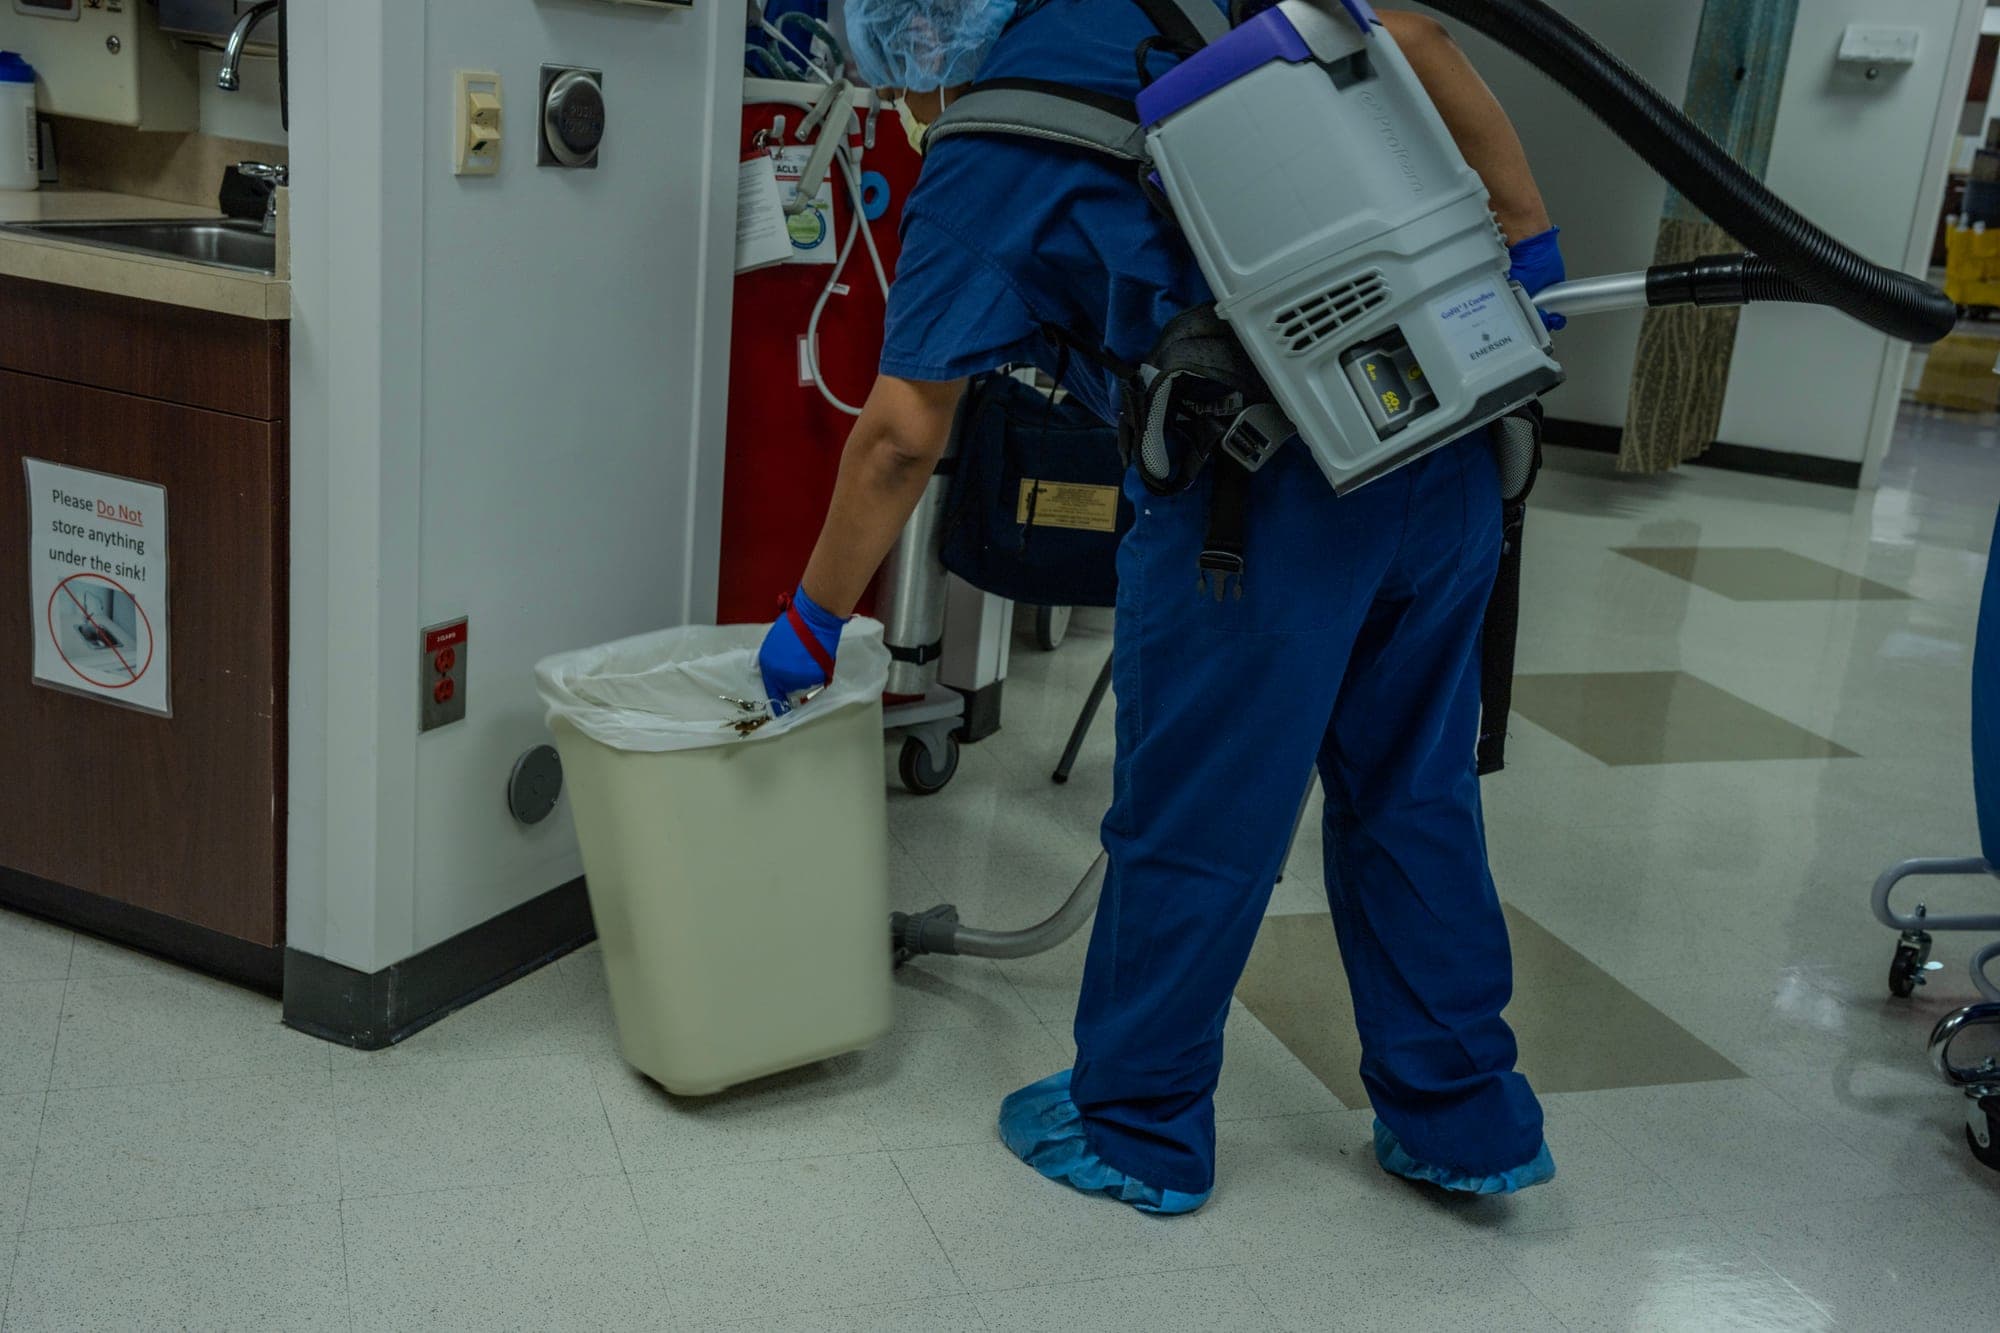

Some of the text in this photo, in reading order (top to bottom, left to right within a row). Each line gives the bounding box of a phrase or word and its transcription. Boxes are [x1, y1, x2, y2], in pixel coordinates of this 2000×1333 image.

[777, 165, 798, 173] ACLS
[1469, 335, 1513, 360] EMERSON
[52, 489, 143, 523] Please Do Not
[52, 520, 145, 556] store anything
[49, 548, 146, 582] under the sink!
